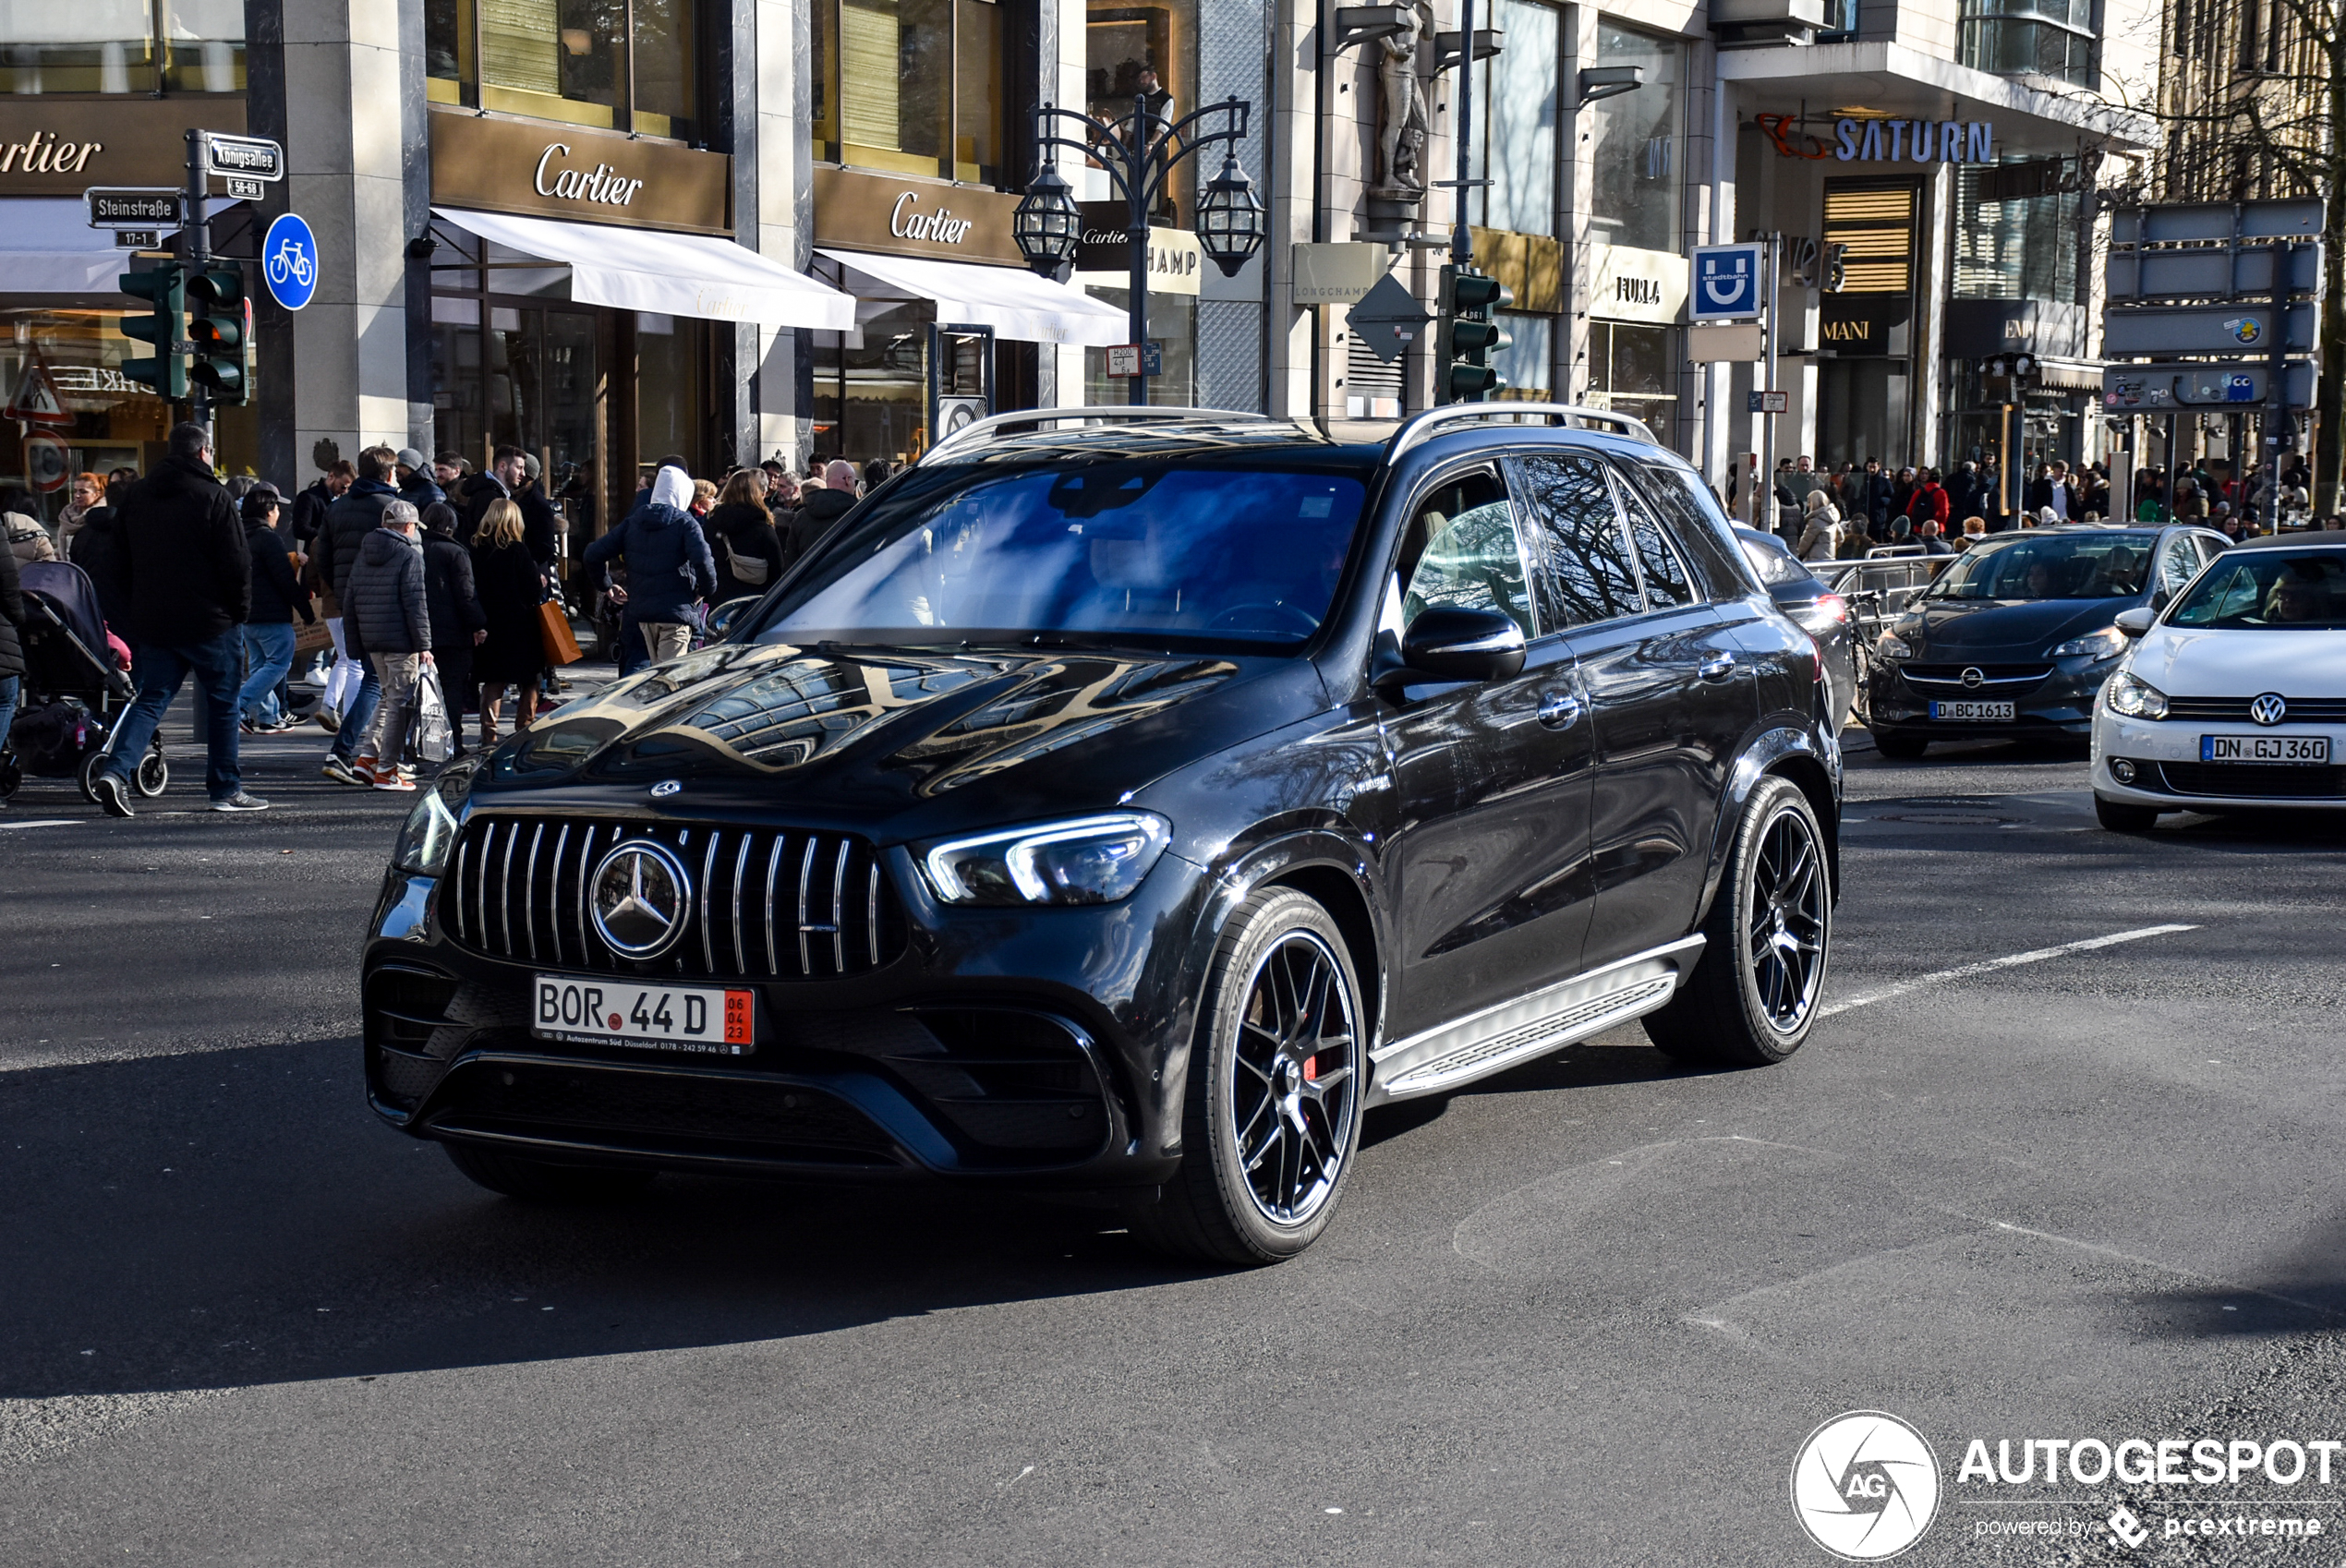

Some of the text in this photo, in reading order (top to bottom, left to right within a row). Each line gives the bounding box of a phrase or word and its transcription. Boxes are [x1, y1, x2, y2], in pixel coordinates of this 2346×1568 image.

[1835, 118, 1992, 163] SATURN
[0, 131, 102, 173] rtier
[218, 146, 272, 168] Königsallee
[535, 143, 643, 206] Cartier
[235, 181, 257, 194] 56-68
[99, 199, 172, 219] Steinstraße
[890, 190, 972, 245] Cartier
[126, 232, 147, 245] 17-1
[1702, 273, 1749, 282] stadtbahn
[1295, 286, 1369, 296] LONGCHAMP
[1615, 276, 1661, 306] FURLA
[696, 287, 750, 318] Cartier
[1028, 314, 1069, 341] Cartier
[1955, 704, 1974, 718] BC
[1977, 704, 2013, 718] 1613
[2215, 739, 2326, 760] DN GJ 360
[539, 983, 707, 1035] BOR 44 D
[728, 997, 744, 1010] 06
[728, 1012, 744, 1024] 04
[728, 1026, 744, 1039] 23
[566, 1034, 608, 1045] Autozentrum
[610, 1038, 623, 1046] Süd
[624, 1040, 658, 1049] Düsseldorf
[660, 1042, 677, 1051] 0178
[683, 1043, 695, 1052] 242
[697, 1044, 706, 1053] 59
[707, 1045, 717, 1054] 46
